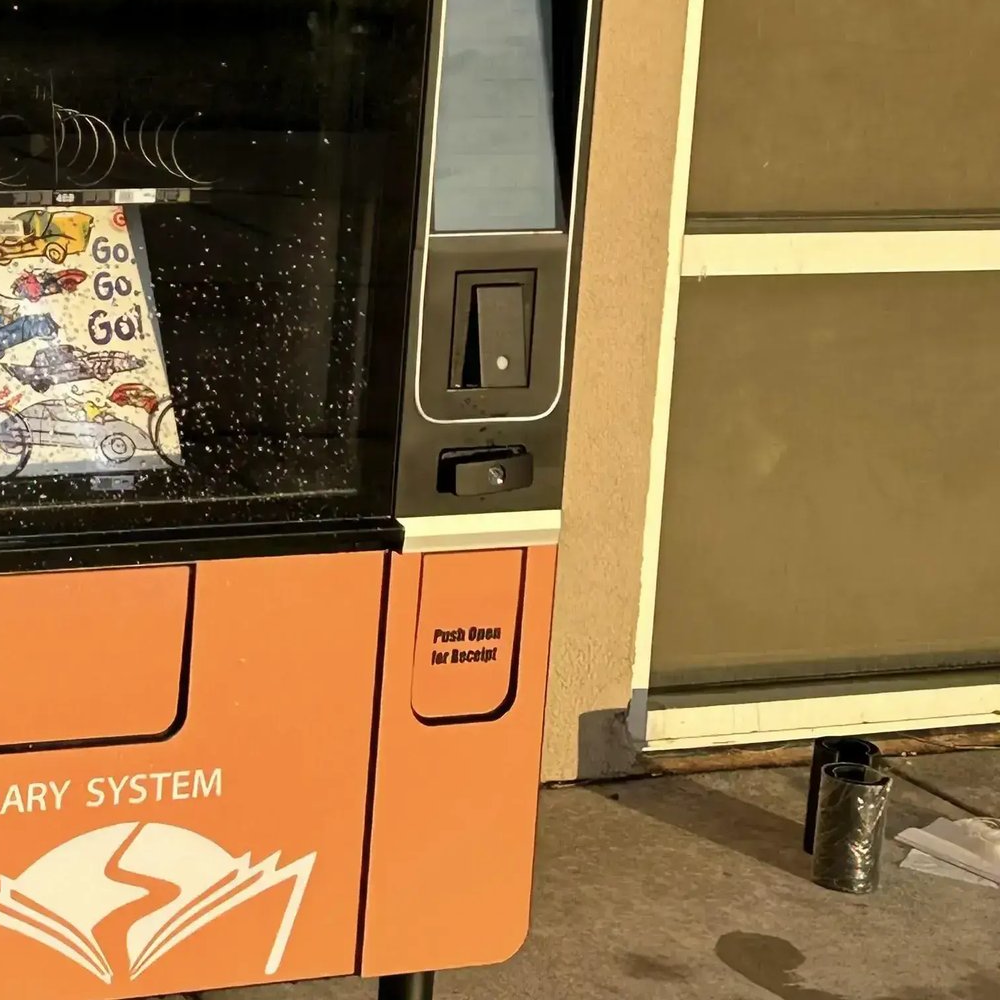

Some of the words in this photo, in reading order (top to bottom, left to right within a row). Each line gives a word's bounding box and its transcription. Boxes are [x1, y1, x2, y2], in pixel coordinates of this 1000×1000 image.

[92, 236, 129, 264] Go
[93, 270, 132, 300] Go
[87, 305, 143, 345] Go!
[433, 628, 465, 644] Push
[467, 625, 502, 642] Open
[430, 650, 449, 666] for
[450, 645, 498, 665] Receipt
[86, 767, 223, 808] SYSTEM
